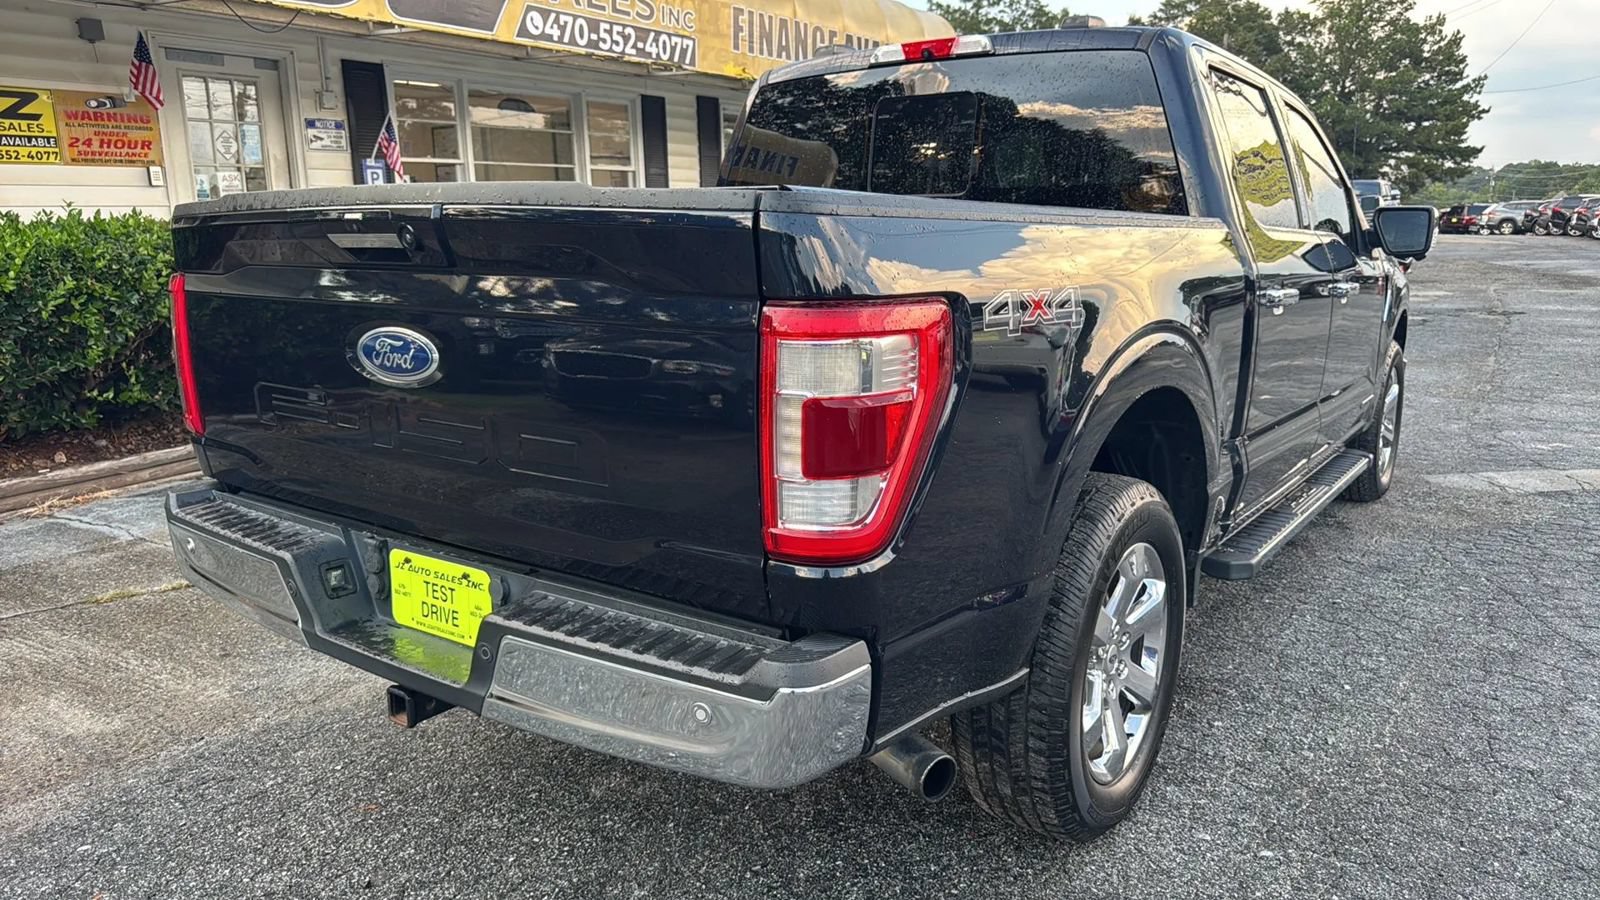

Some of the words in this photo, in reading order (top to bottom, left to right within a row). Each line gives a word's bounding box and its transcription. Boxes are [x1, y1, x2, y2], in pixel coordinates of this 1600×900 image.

[661, 5, 696, 31] INC
[544, 12, 694, 65] 470-552-4077
[63, 110, 151, 125] WARNING
[315, 120, 336, 129] NOTICE
[0, 121, 45, 133] SALES
[77, 122, 110, 130] ACTIVITIES
[94, 130, 129, 138] UNDER
[1, 136, 57, 147] AVAILABLE
[68, 137, 93, 148] 24
[98, 138, 152, 151] HOUR
[76, 149, 150, 158] SURVEILLANCE
[372, 338, 415, 369] Ford
[395, 560, 406, 570] JZ
[408, 565, 431, 577] AUTO
[433, 571, 463, 586] SALES
[423, 580, 456, 604] TEST
[421, 601, 459, 627] DRIVE
